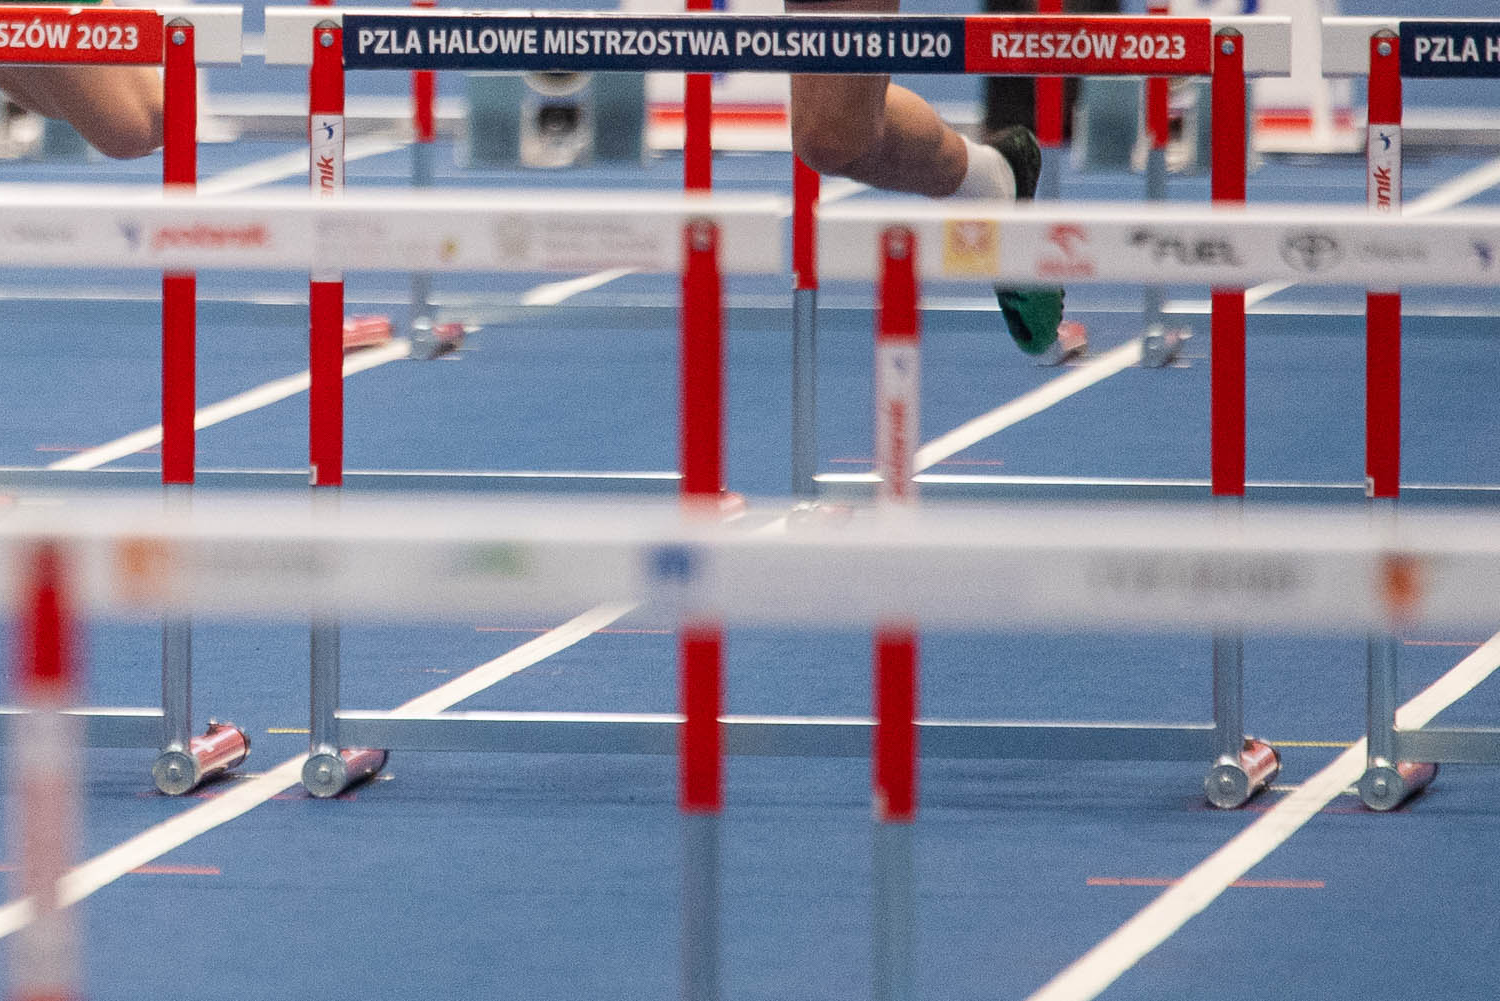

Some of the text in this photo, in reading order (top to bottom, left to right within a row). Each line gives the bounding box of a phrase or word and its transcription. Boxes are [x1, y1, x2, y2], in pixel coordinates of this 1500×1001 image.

[77, 24, 138, 50] 2023
[358, 29, 1187, 61] PZLA HALOWE MISTRZOSTWA POLSKI U18 i U20 RZESZÓW 2023
[1414, 37, 1480, 63] PZLA
